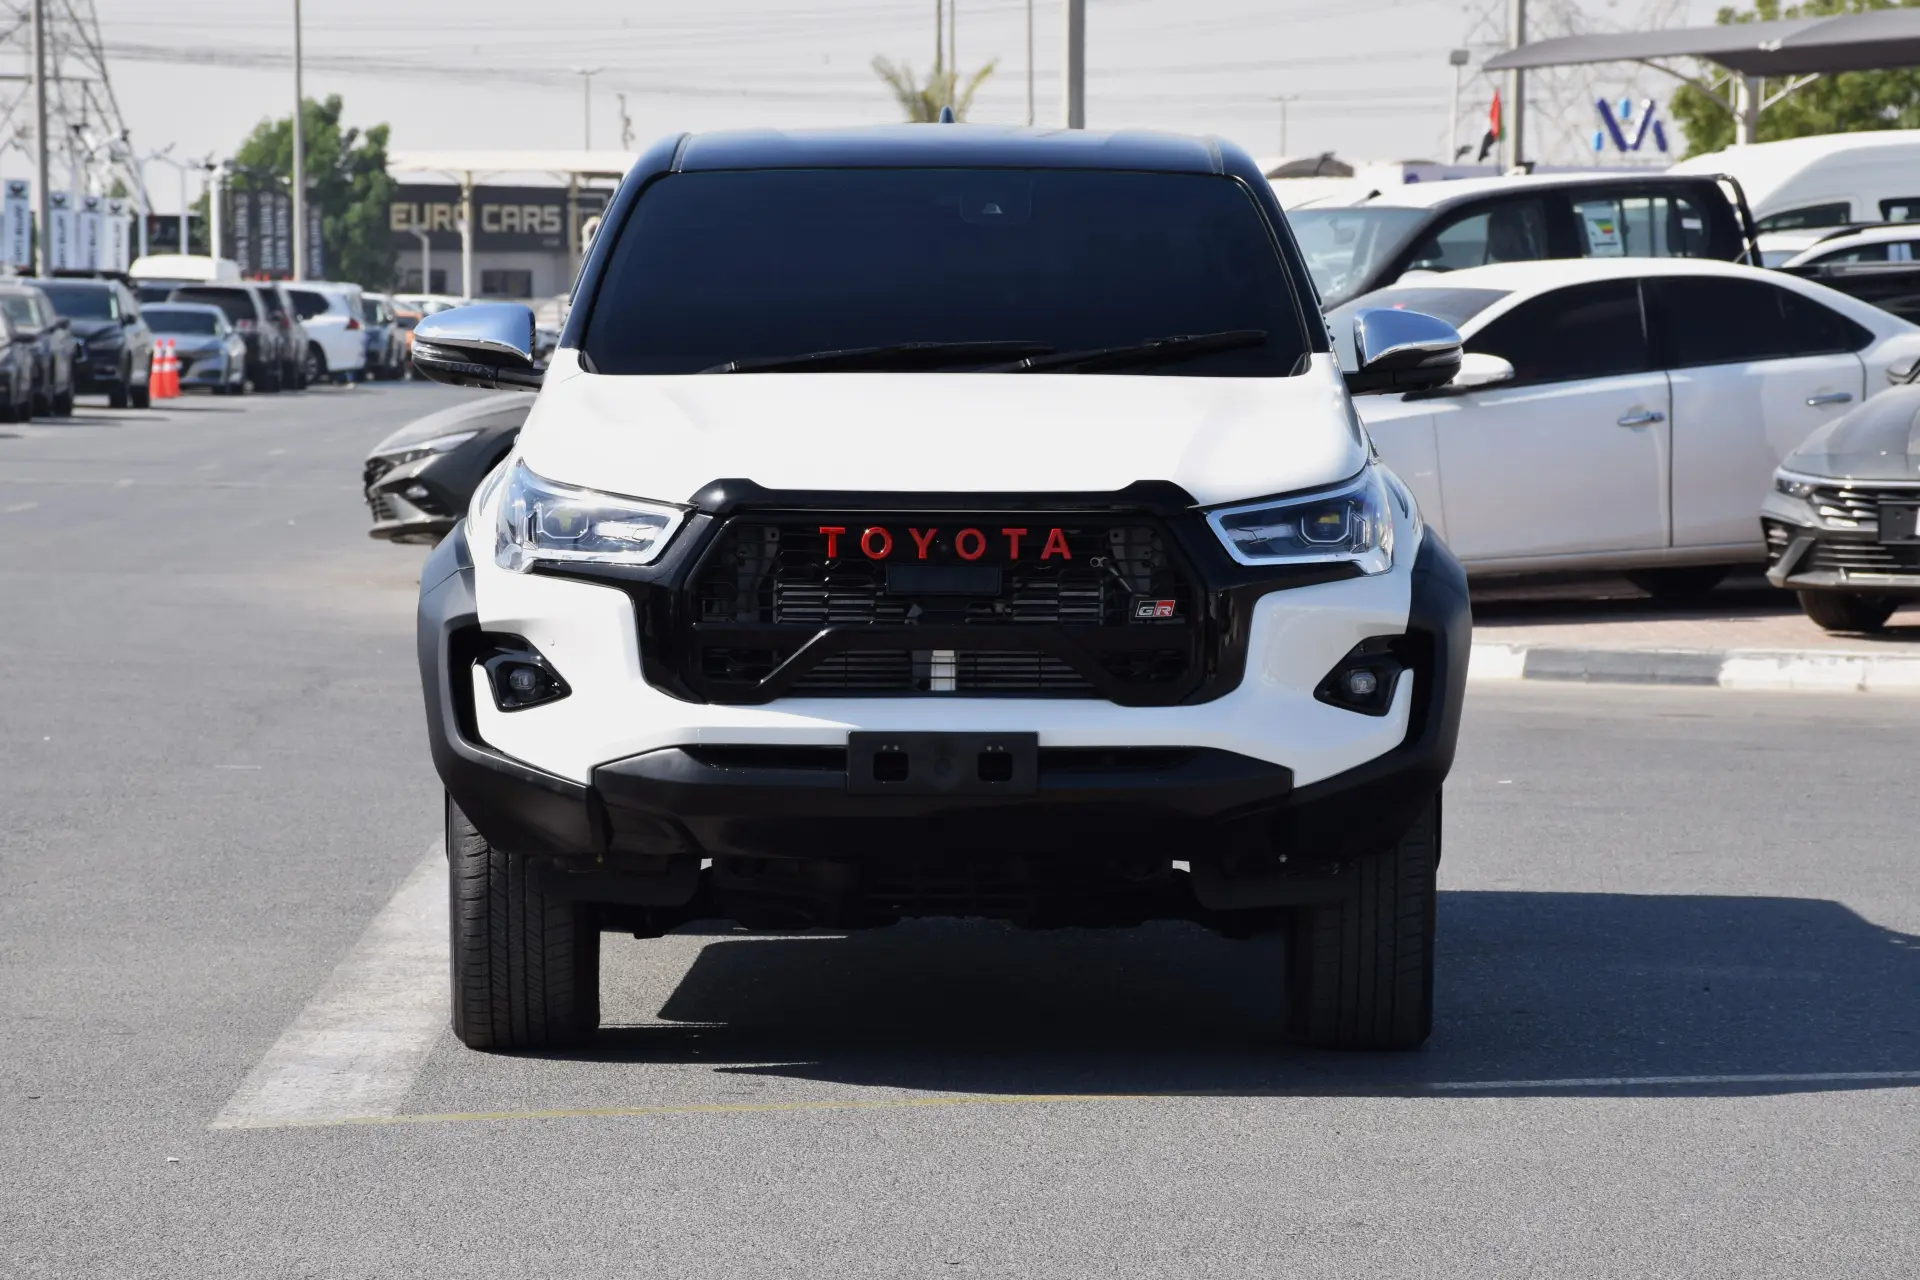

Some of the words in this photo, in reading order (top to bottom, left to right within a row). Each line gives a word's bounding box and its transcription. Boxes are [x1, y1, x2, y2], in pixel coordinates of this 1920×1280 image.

[481, 204, 562, 233] CARS
[819, 526, 1072, 560] TOYOTA
[1138, 604, 1173, 616] GR
